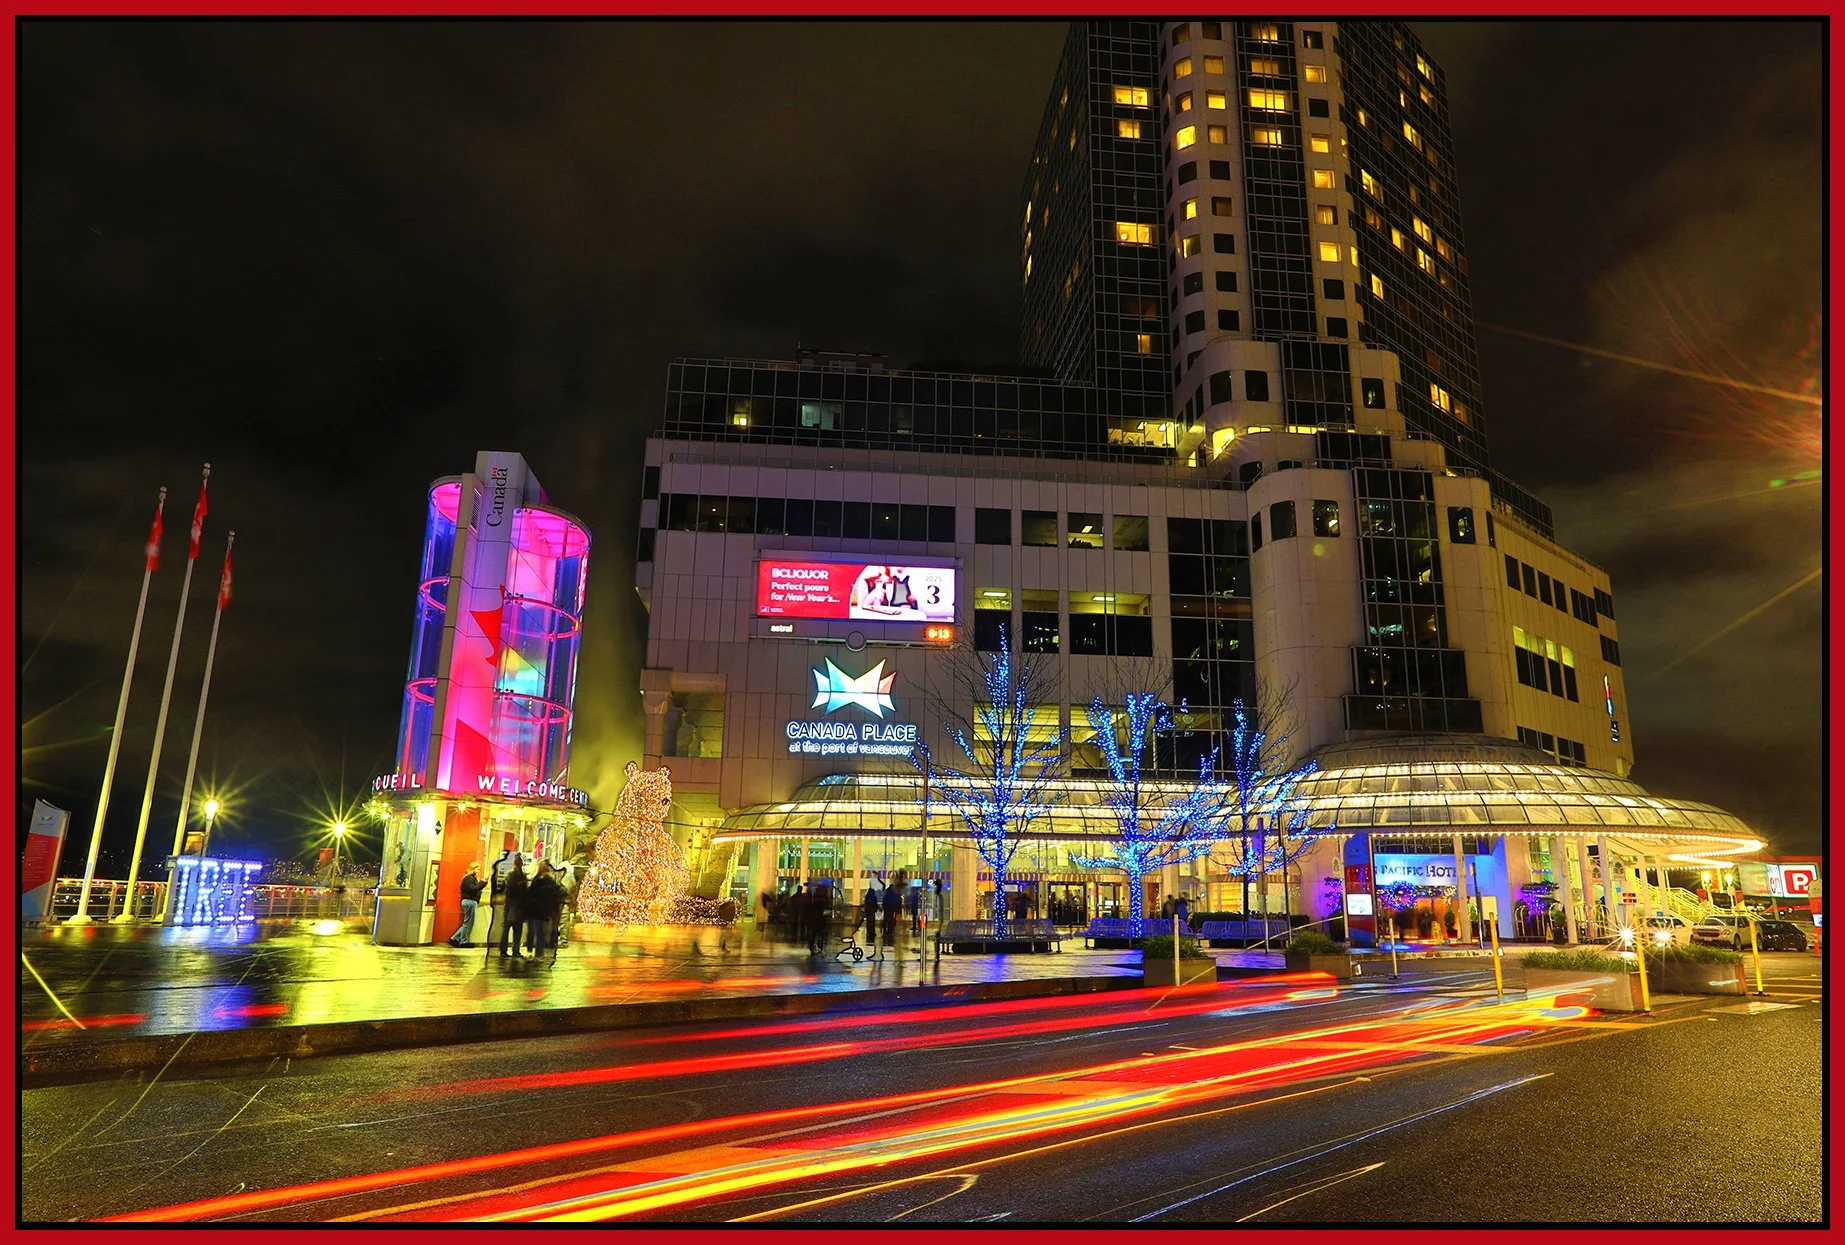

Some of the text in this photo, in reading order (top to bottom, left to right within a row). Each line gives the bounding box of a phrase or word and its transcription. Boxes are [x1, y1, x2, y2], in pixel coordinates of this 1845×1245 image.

[486, 467, 509, 527] Canada
[772, 568, 829, 580] BCLIQUOR
[771, 581, 829, 592] Perfect pours
[926, 584, 940, 605] 3
[771, 592, 784, 600] for
[785, 592, 806, 601] New
[787, 721, 917, 742] CANADA PLACE
[789, 740, 915, 755] at the port of vancouver
[477, 775, 567, 801] WELCOME
[1378, 864, 1424, 876] PACIFIC
[1791, 872, 1809, 892] P
